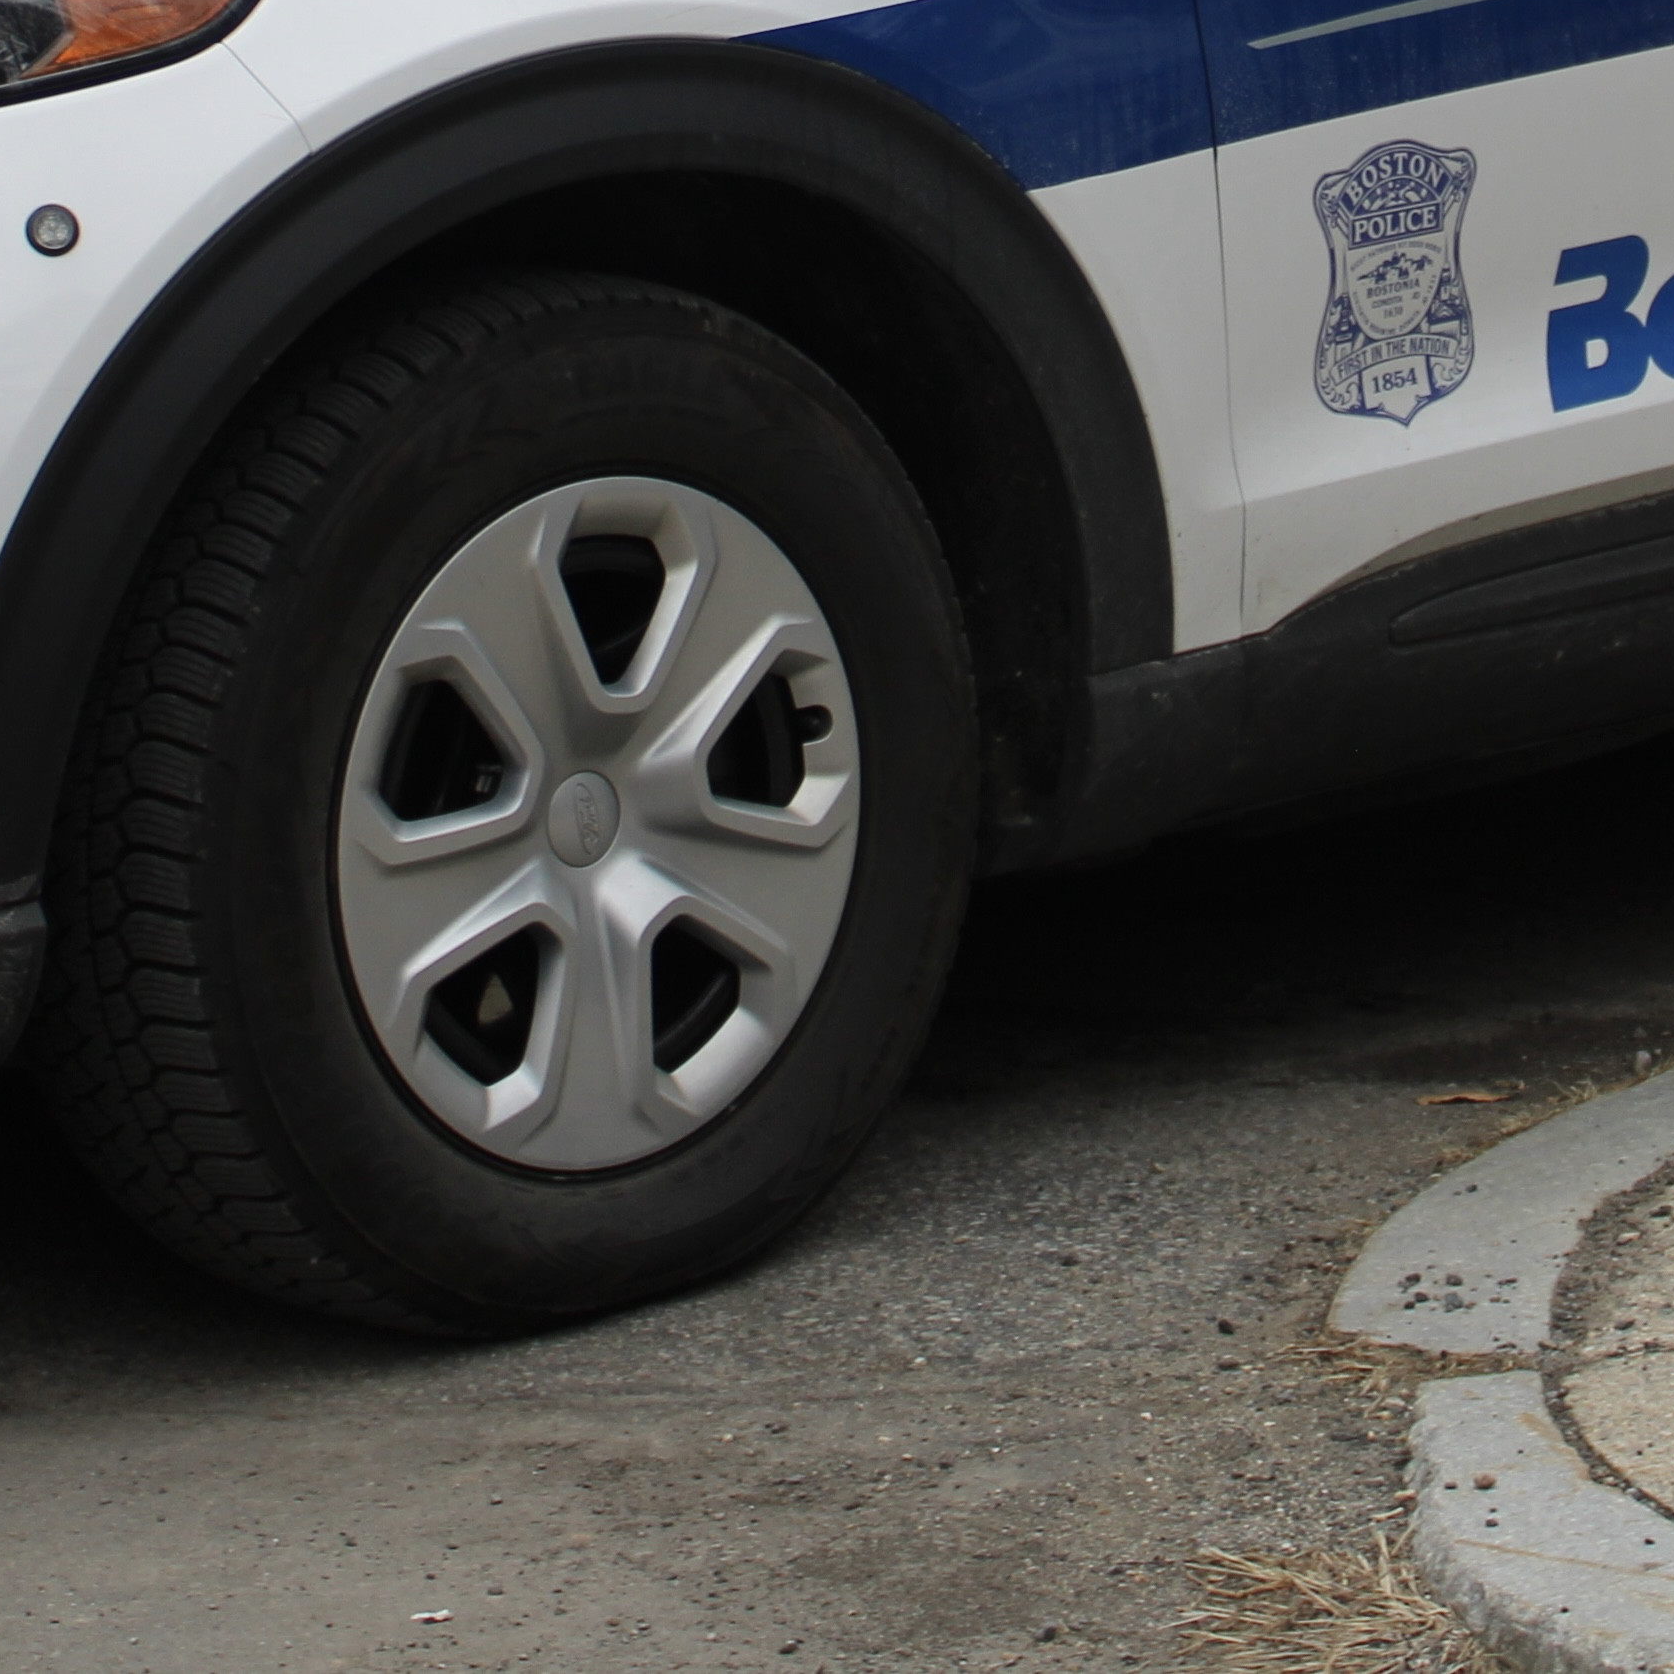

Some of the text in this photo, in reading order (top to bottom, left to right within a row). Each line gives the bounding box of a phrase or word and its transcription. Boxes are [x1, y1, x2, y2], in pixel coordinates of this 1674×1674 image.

[1346, 152, 1445, 206] BOSTON
[1353, 206, 1437, 243] POLICE
[1337, 336, 1451, 379] FIRST IN THE NATION
[1372, 367, 1417, 394] 1854
